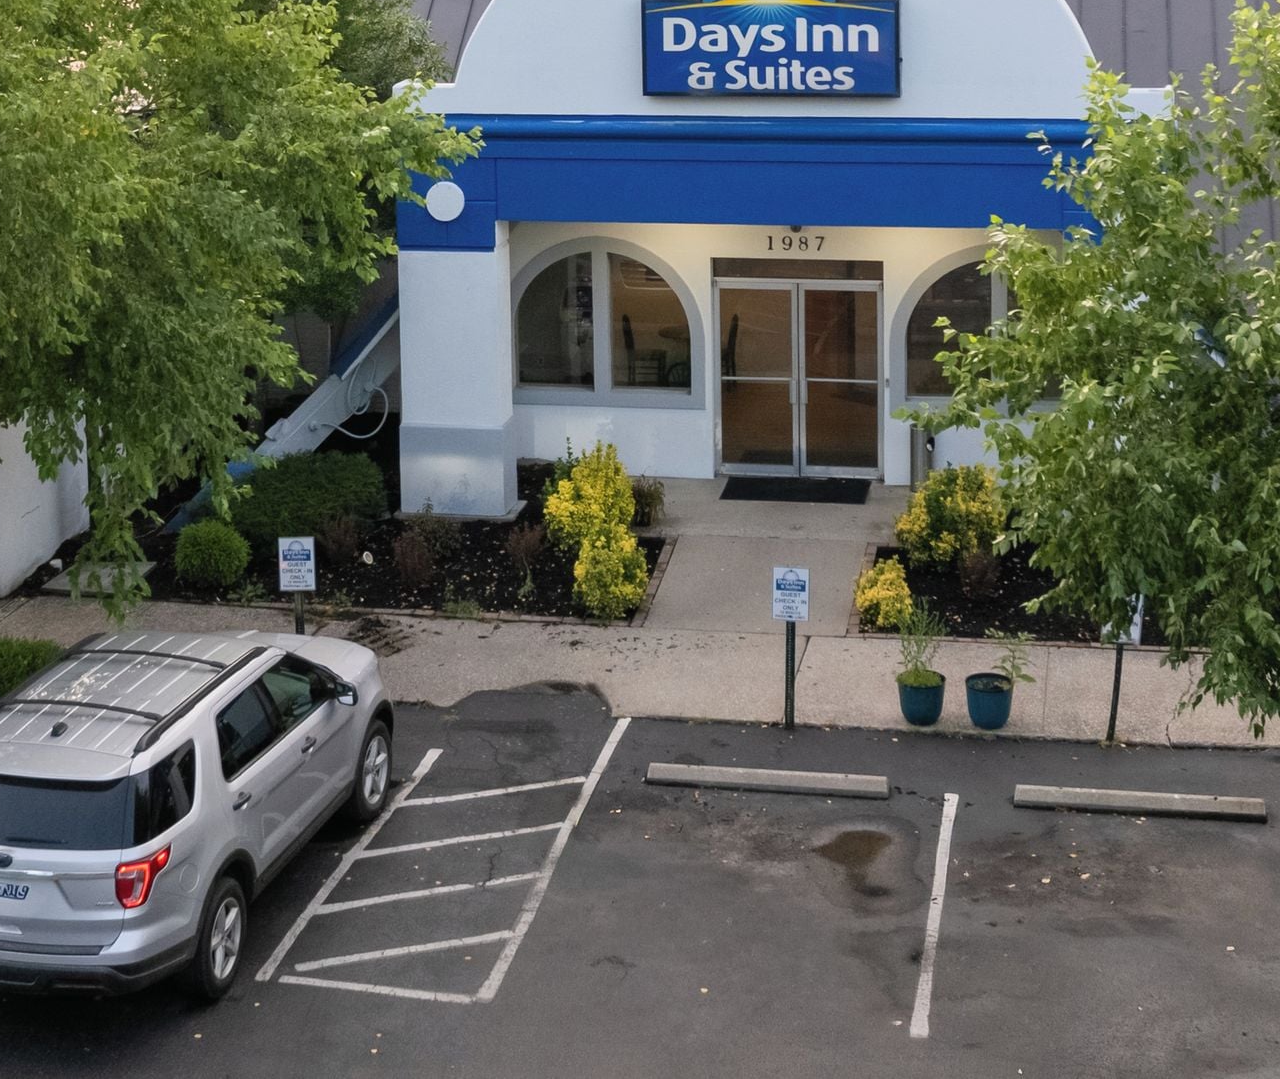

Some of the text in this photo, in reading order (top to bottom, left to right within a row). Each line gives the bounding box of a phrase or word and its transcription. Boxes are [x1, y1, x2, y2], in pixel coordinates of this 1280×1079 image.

[662, 17, 880, 58] Days Inn
[687, 57, 855, 91] & Suites
[767, 235, 825, 251] 1987
